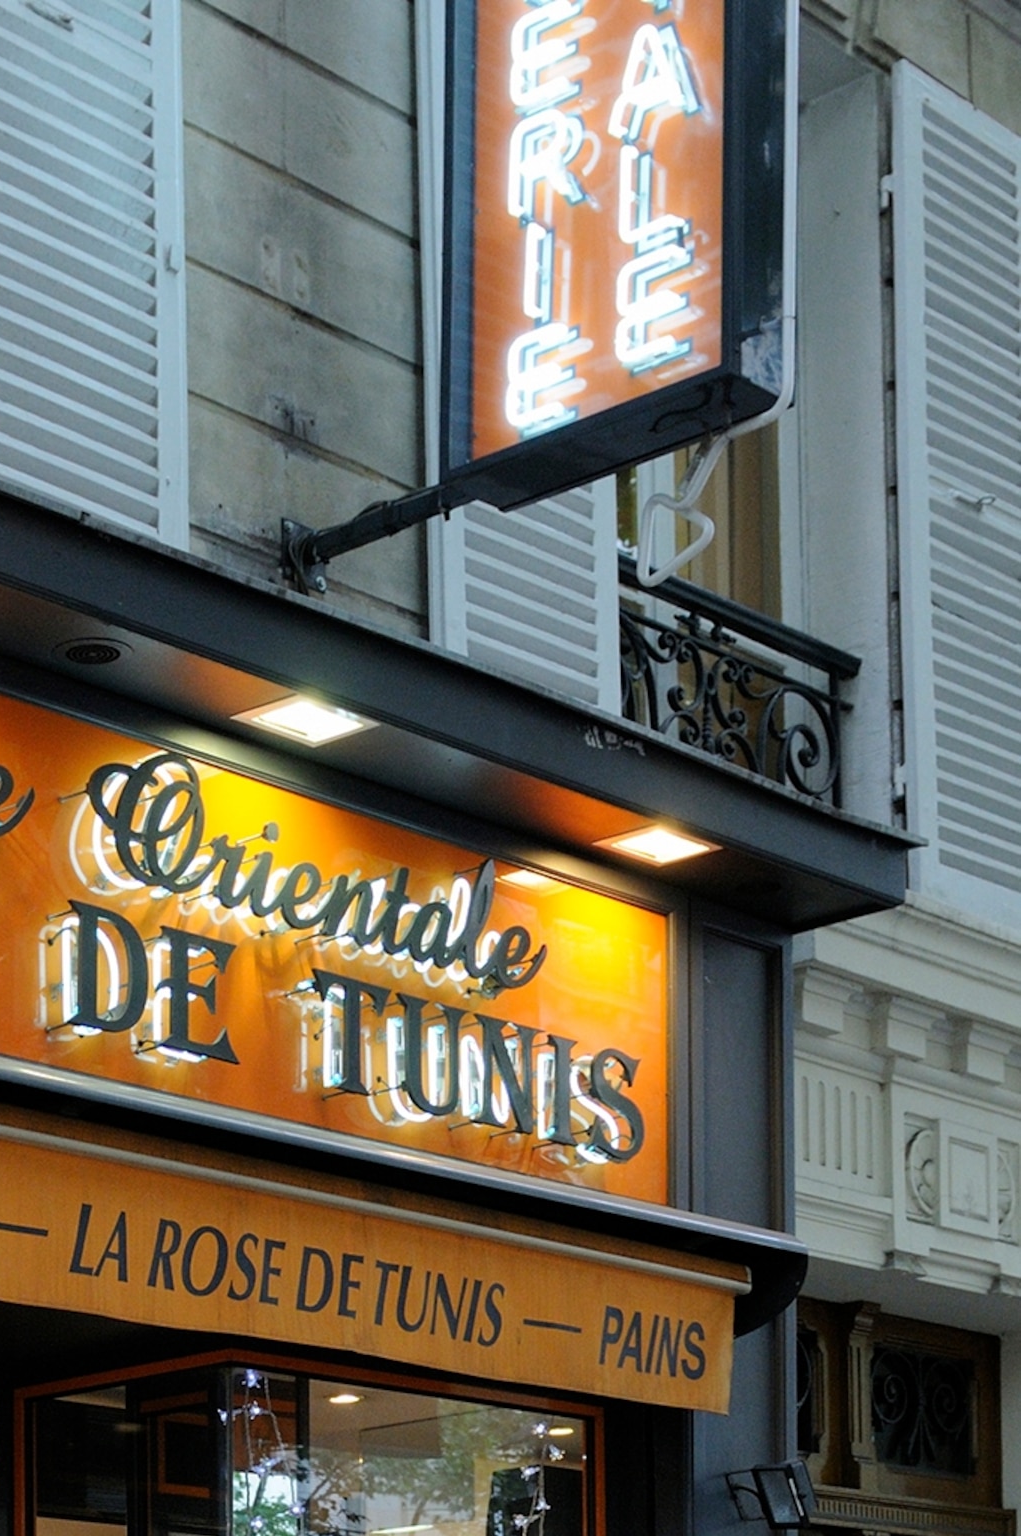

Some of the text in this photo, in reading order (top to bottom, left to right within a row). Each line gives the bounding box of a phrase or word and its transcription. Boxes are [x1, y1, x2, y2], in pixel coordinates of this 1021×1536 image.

[505, 0, 589, 437] ERIE
[608, 0, 702, 376] ALE
[88, 752, 547, 990] Orientale
[68, 899, 240, 1064] DE
[313, 968, 646, 1163] TUNIS
[69, 1203, 129, 1282] LA
[148, 1218, 287, 1304] ROSE
[297, 1247, 363, 1317] DE
[374, 1260, 506, 1347] TUNIS
[600, 1305, 706, 1381] PAINS
